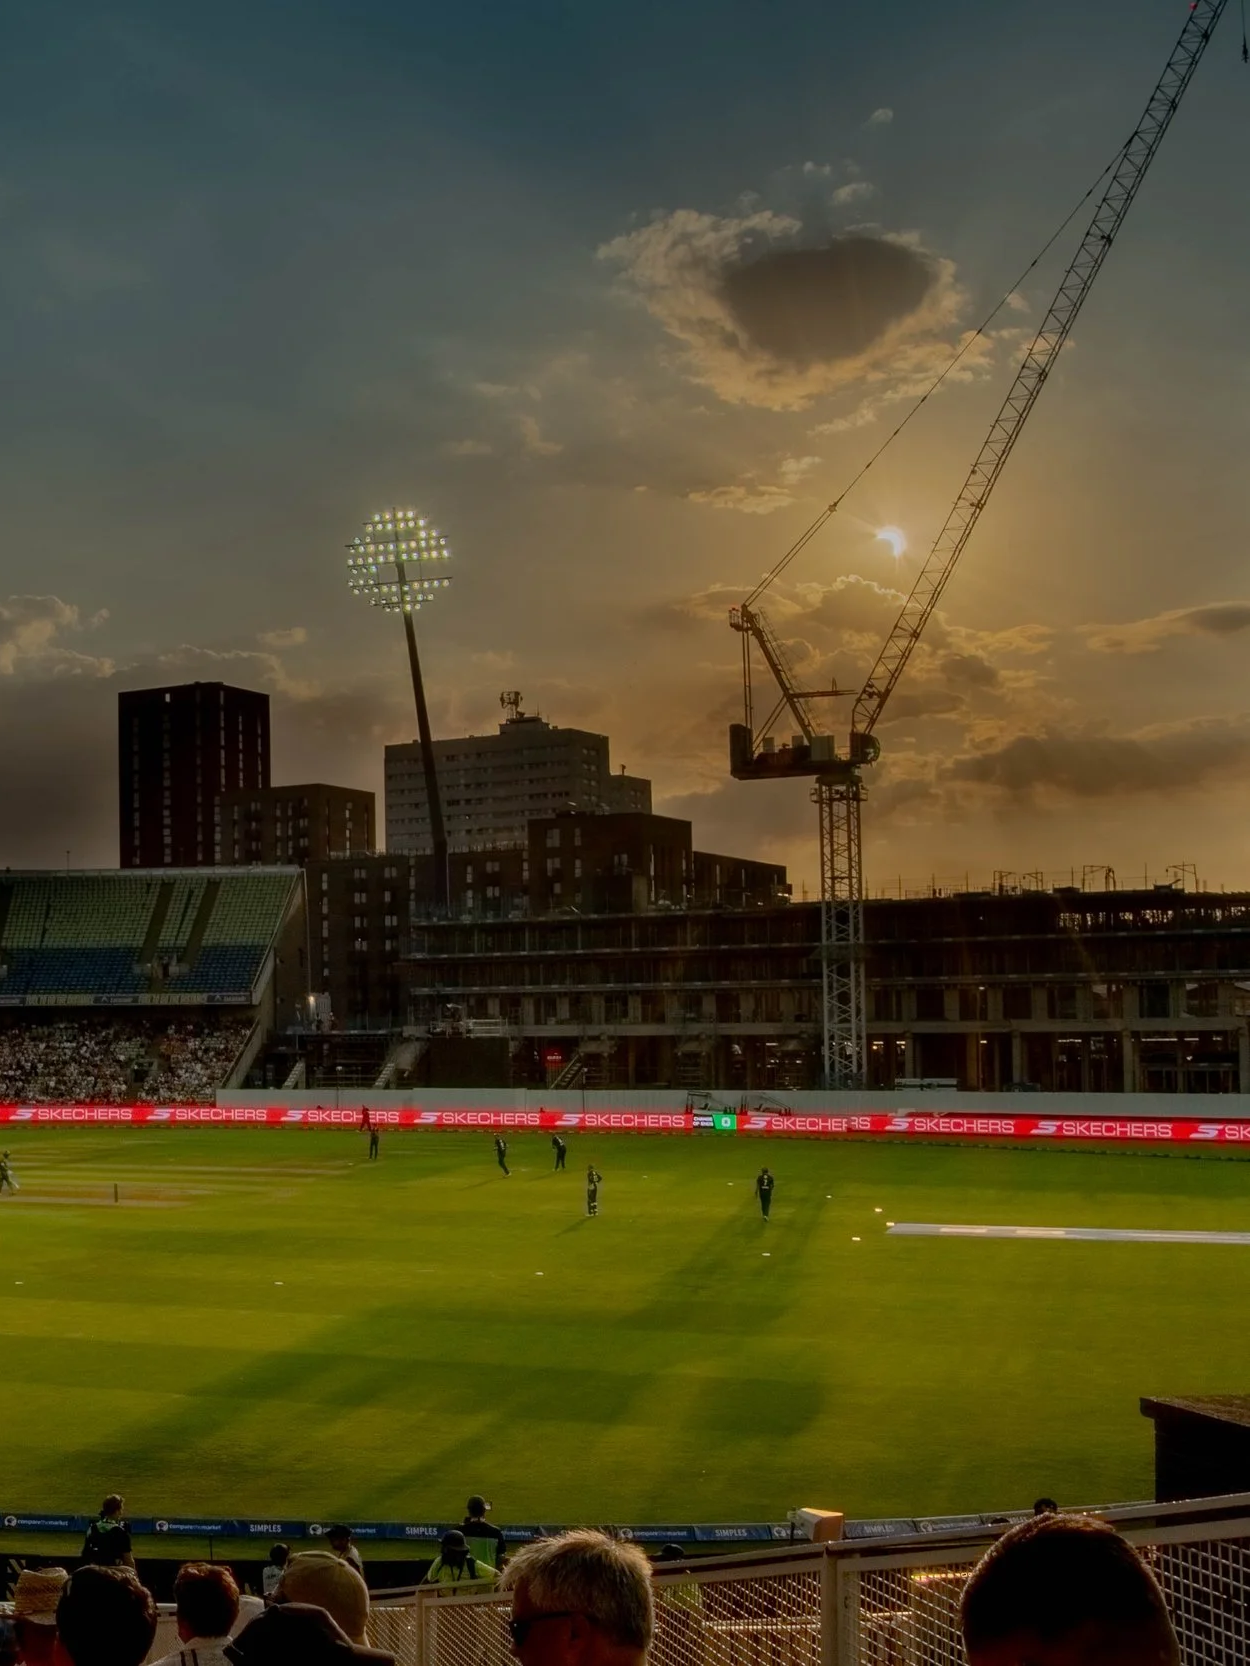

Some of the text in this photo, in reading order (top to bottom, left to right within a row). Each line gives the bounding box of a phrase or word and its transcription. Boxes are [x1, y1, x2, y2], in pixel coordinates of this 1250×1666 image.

[37, 1109, 133, 1121] SKECHERS
[175, 1109, 267, 1120] SKECHERS
[442, 1112, 540, 1125] SKECHERS
[584, 1113, 686, 1127] SKECHERS
[914, 1118, 1015, 1134] SKECHERS
[1062, 1120, 1174, 1137] SKECHERS
[250, 1524, 282, 1534] SIMPLES
[405, 1526, 438, 1536] SIMPLES
[715, 1528, 748, 1538] SIMPLES
